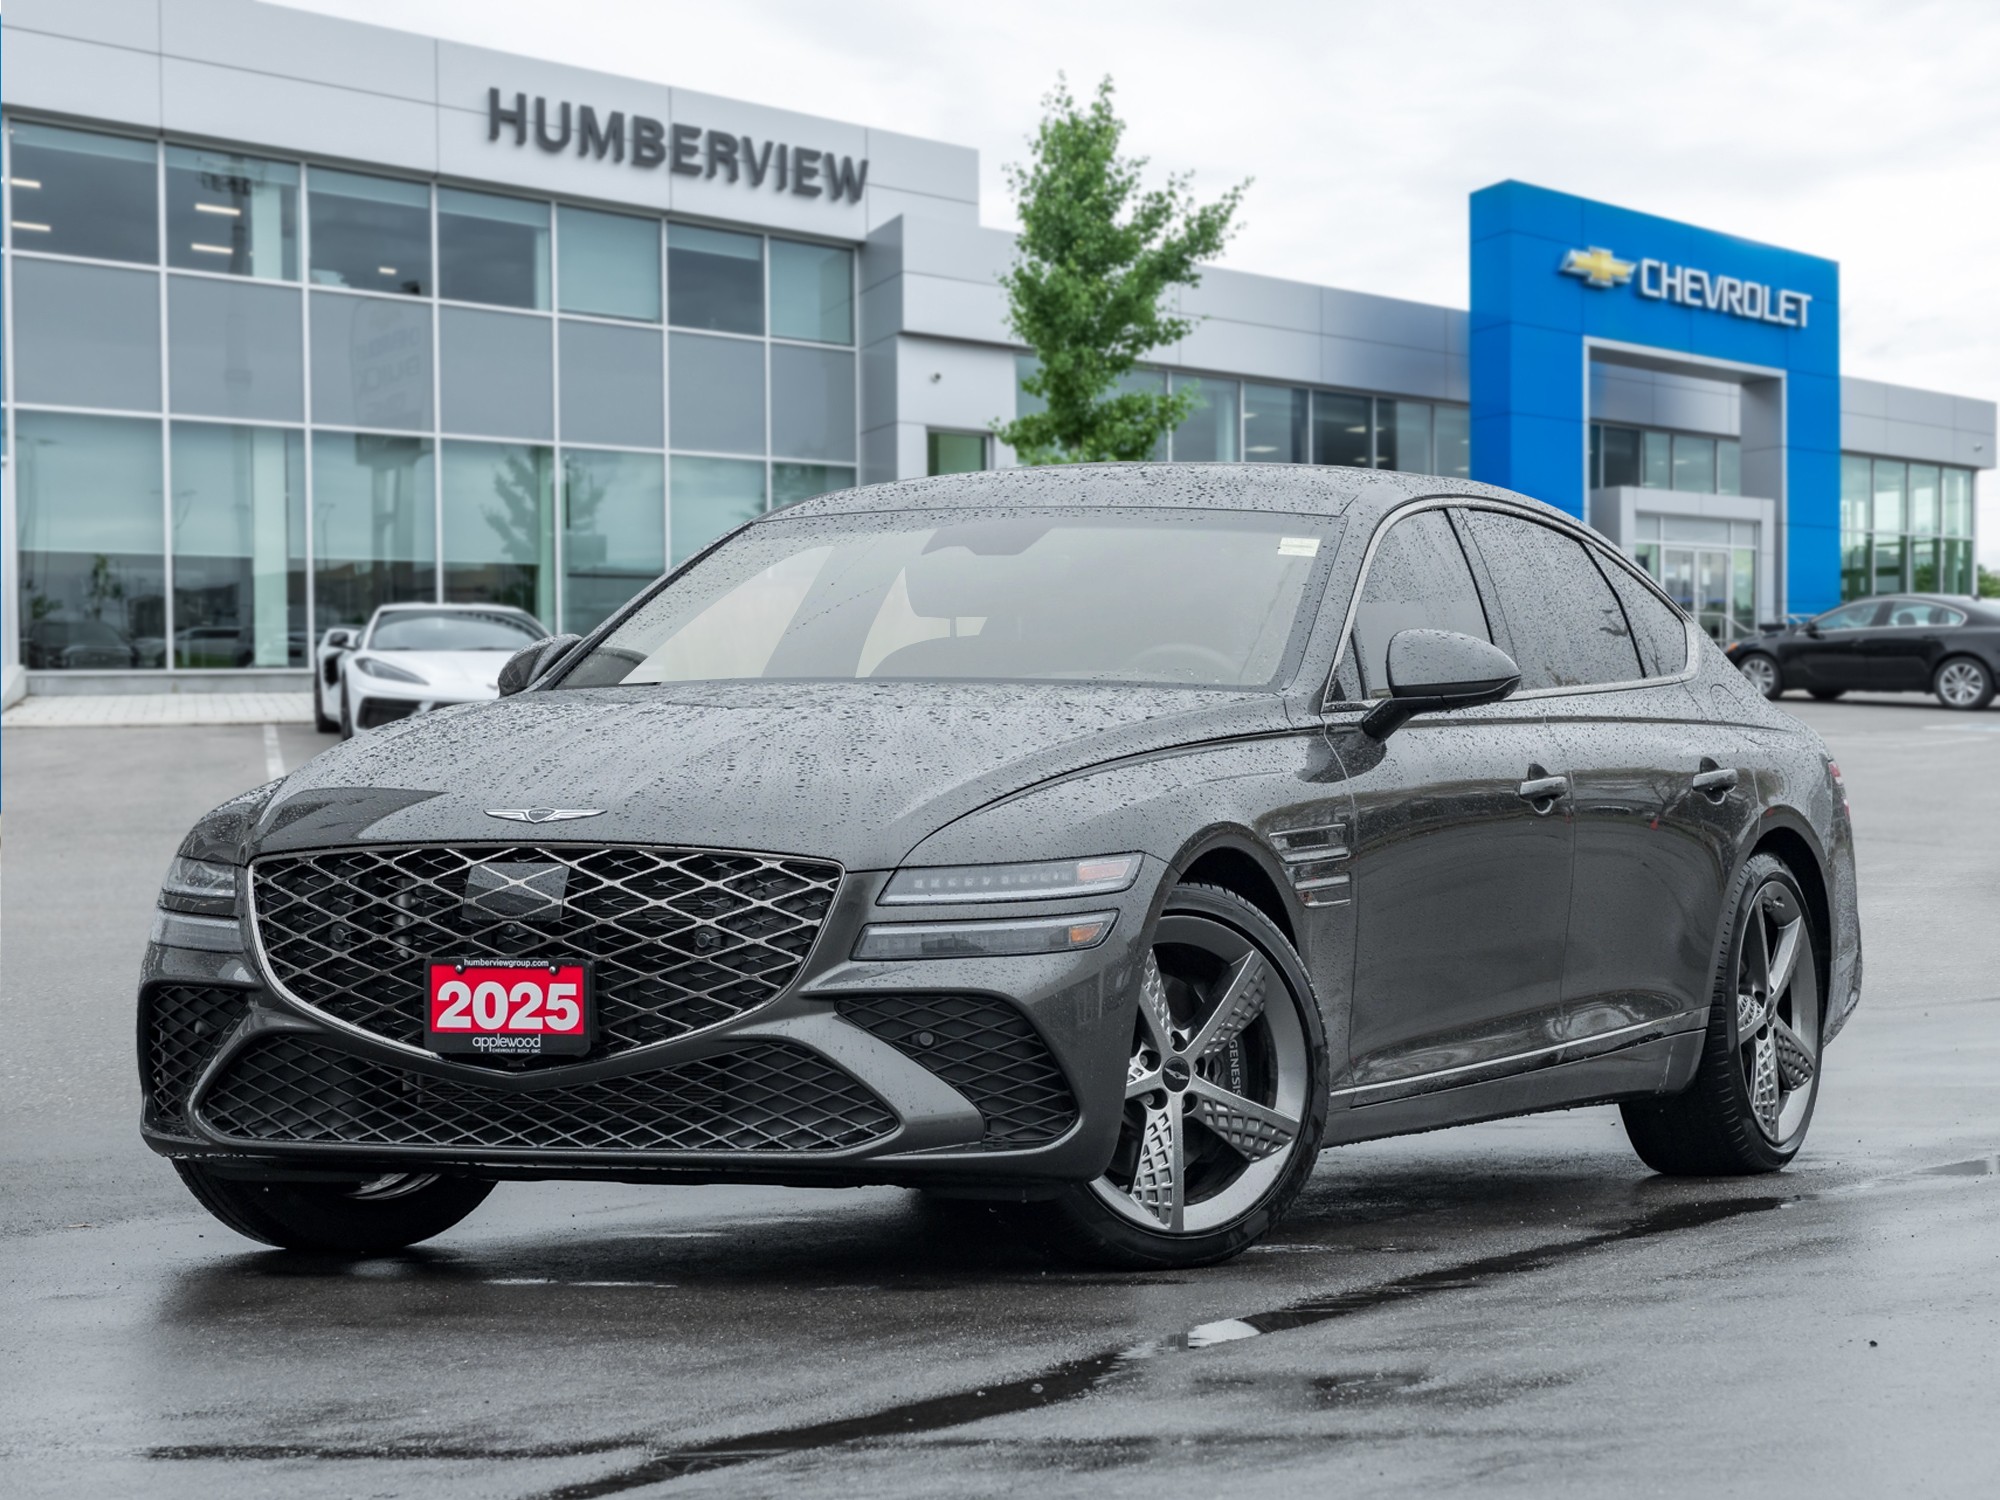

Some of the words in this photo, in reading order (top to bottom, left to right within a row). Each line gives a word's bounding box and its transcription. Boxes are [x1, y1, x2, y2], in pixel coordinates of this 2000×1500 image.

[488, 87, 869, 204] HUMBERVIEW
[1641, 257, 1813, 328] CHEVROLET
[463, 958, 549, 968] humberviewgroup.com
[436, 980, 580, 1031] 2025
[472, 1033, 541, 1052] applewood
